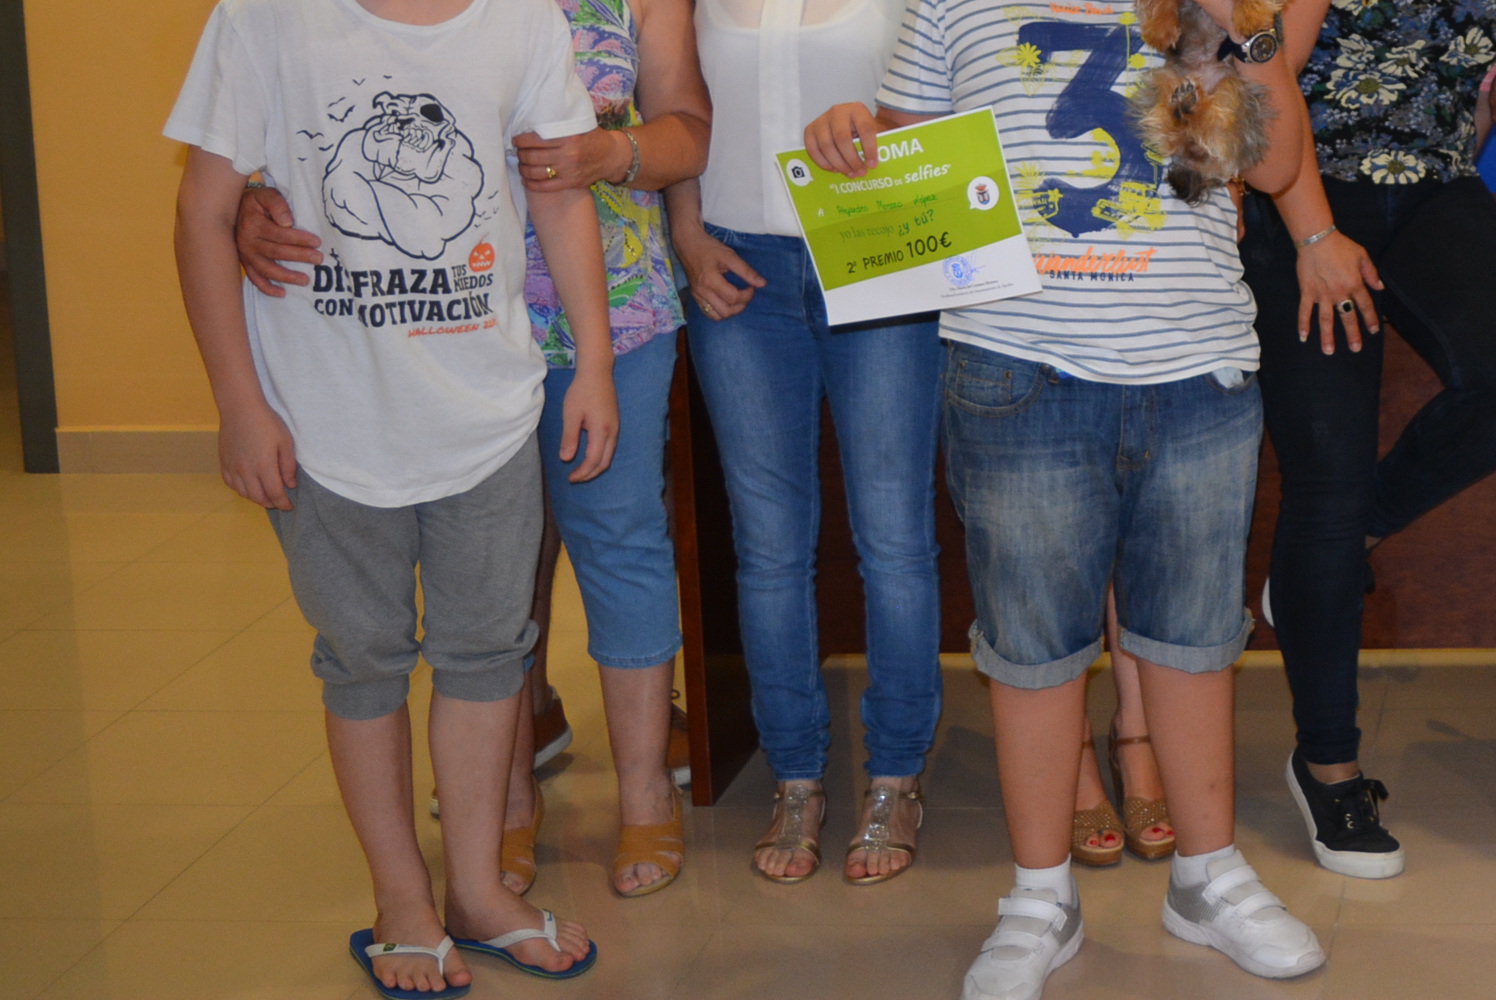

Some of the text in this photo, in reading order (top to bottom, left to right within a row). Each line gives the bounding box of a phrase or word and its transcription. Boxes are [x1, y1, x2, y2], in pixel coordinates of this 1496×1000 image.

[1018, 21, 1167, 238] 3
[840, 177, 893, 193] CONCURSO
[898, 223, 910, 237] ¿y
[914, 209, 934, 226] tú?
[862, 250, 904, 270] PREMIO
[906, 231, 952, 258] 100€
[451, 264, 466, 277] TUS
[1050, 270, 1134, 282] SANTA MONICA
[314, 299, 354, 316] CON
[408, 323, 479, 338] HALLOWEEN
